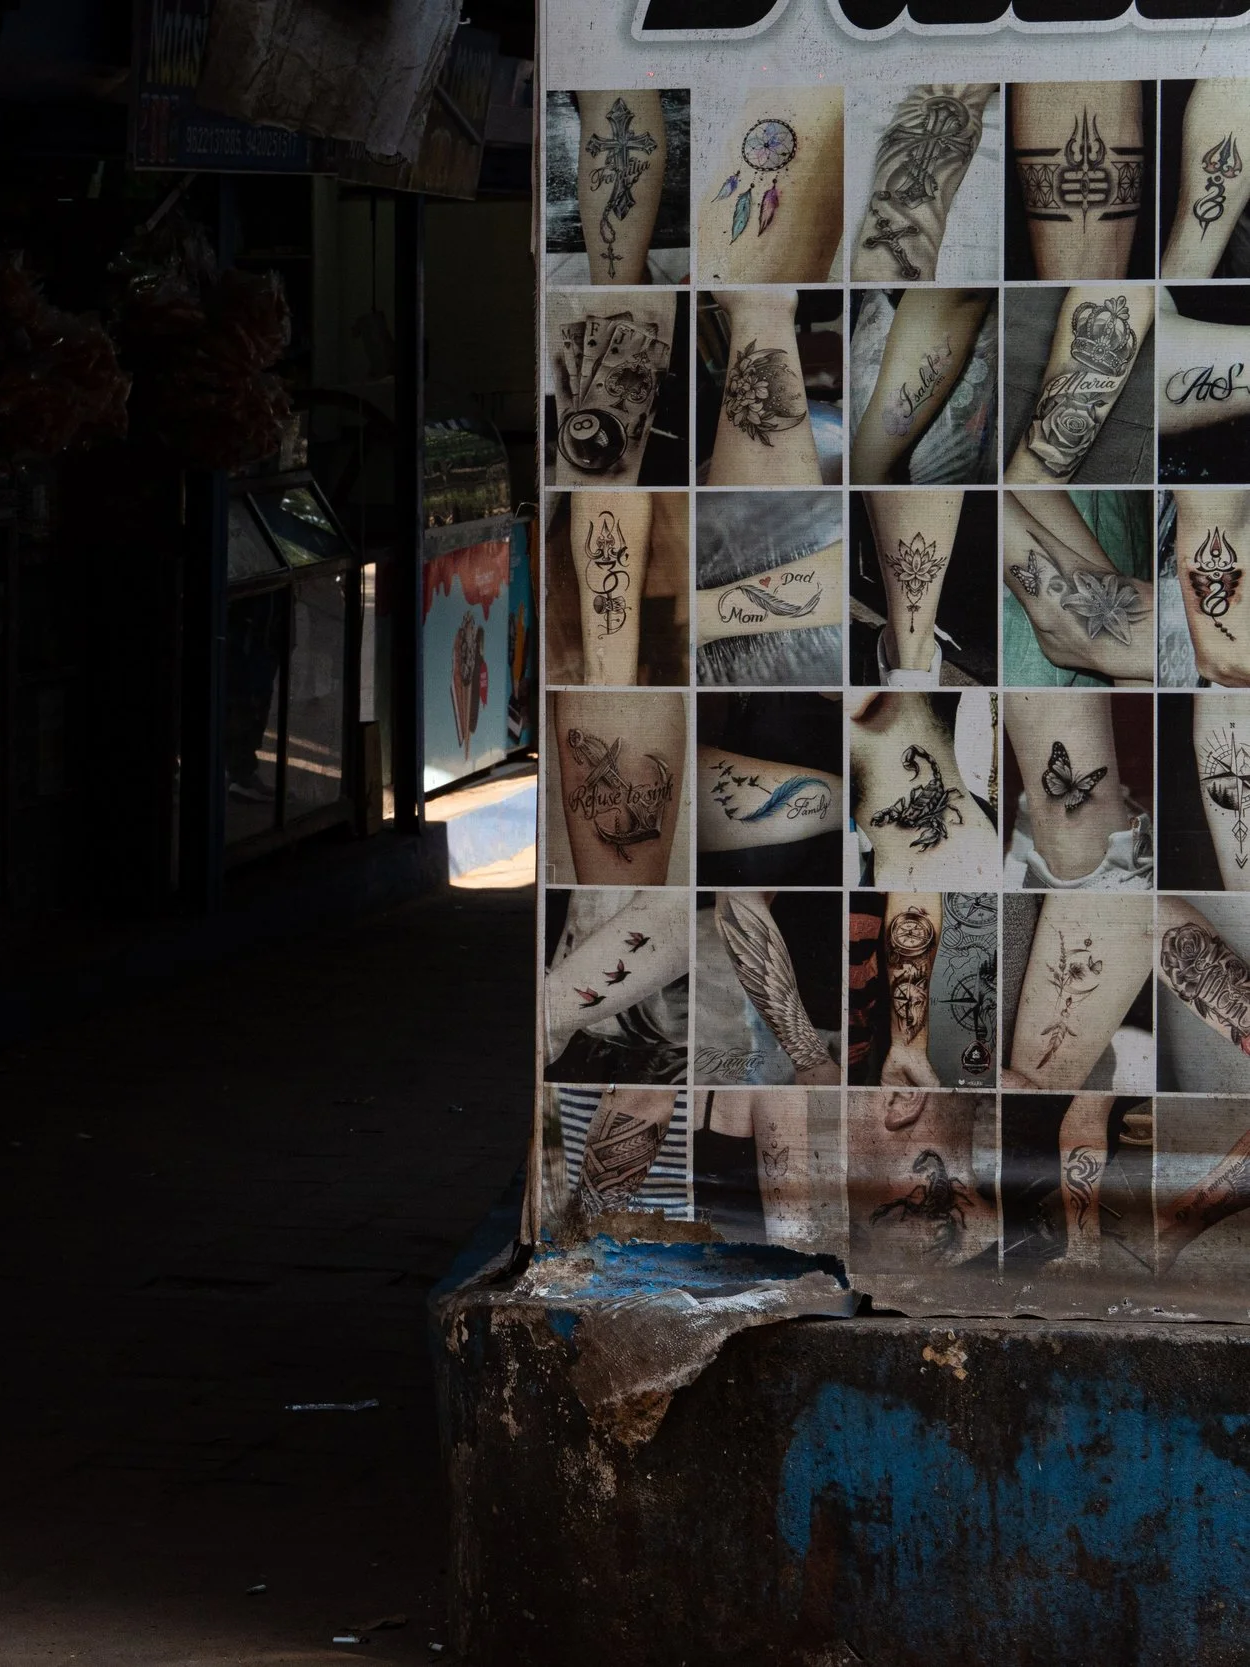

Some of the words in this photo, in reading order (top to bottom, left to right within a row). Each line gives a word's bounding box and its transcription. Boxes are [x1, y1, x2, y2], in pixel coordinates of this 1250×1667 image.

[1046, 371, 1117, 398] Maria
[781, 571, 816, 586] Dad
[722, 606, 766, 625] Mom
[568, 783, 622, 821] Refuse
[626, 782, 642, 805] to
[786, 794, 832, 820] Family
